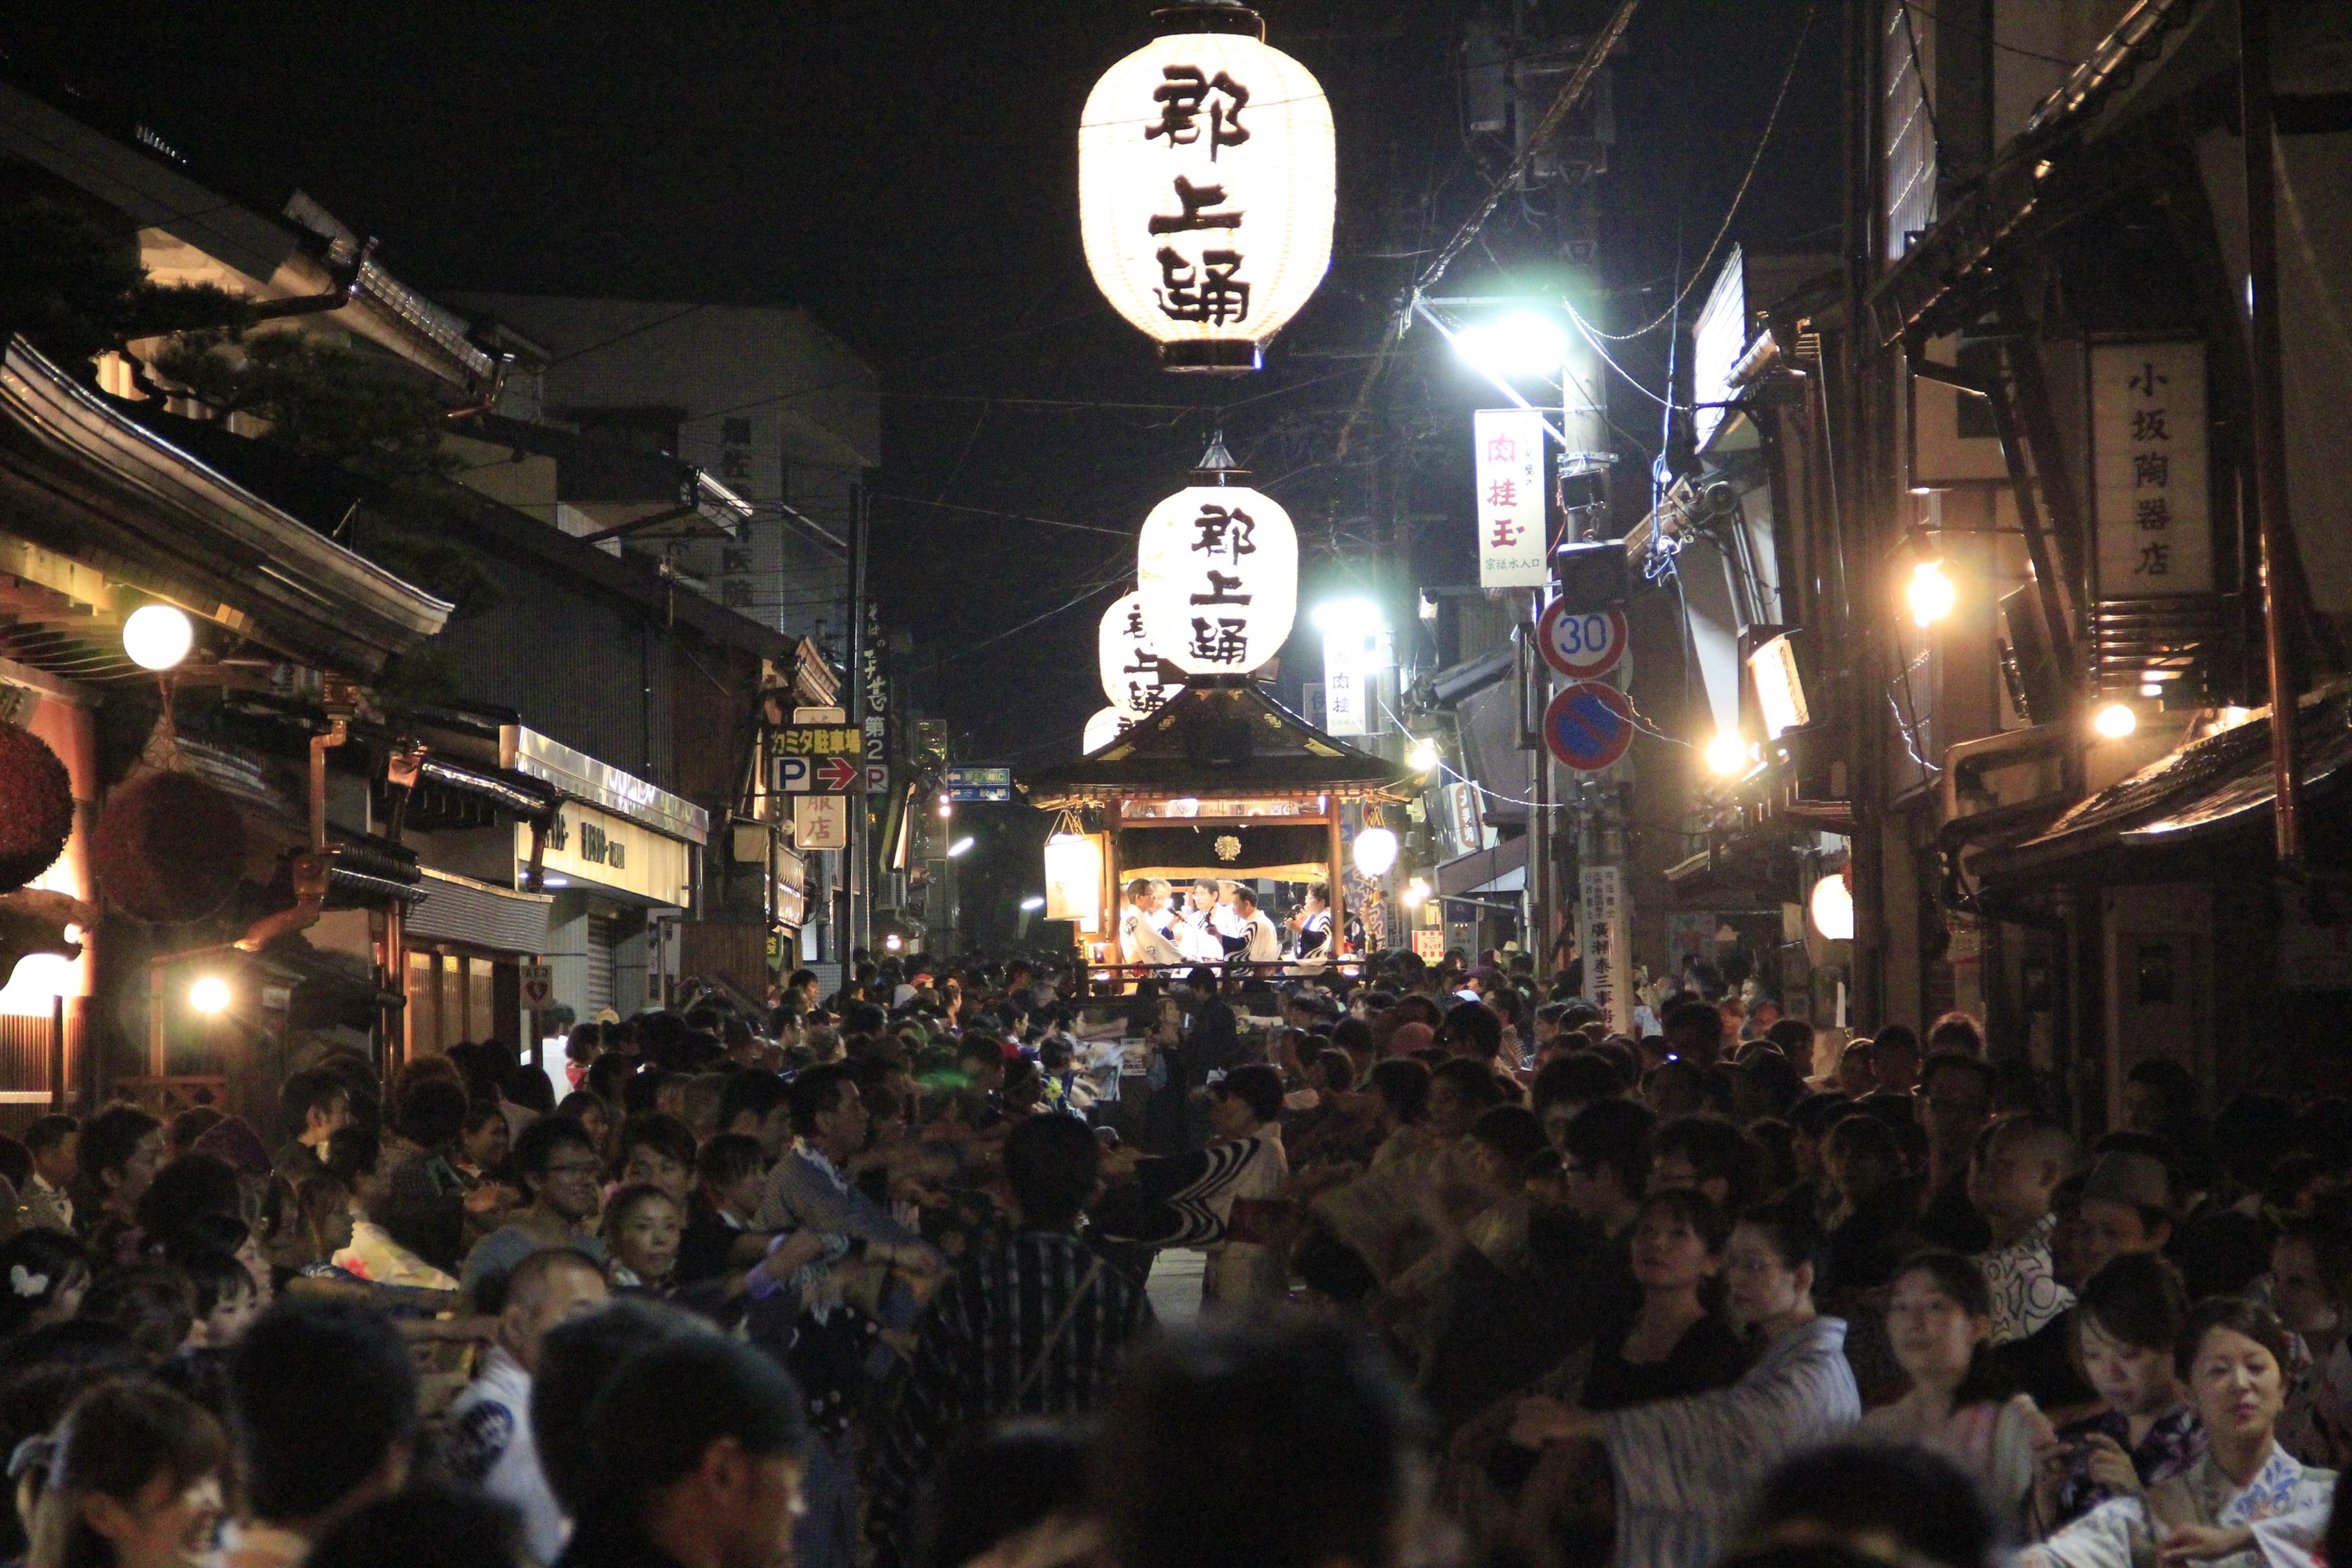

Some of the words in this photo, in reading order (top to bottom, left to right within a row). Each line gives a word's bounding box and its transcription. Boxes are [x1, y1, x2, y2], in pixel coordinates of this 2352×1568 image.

[1145, 64, 1250, 327] 郡上踊
[1486, 433, 1525, 548] 肉桂玉
[2128, 362, 2170, 576] 小坂陶器店
[1189, 504, 1256, 664] 郡上踊
[1559, 614, 1606, 655] 30
[771, 729, 861, 755] カミタ駐車場
[780, 759, 806, 790] P
